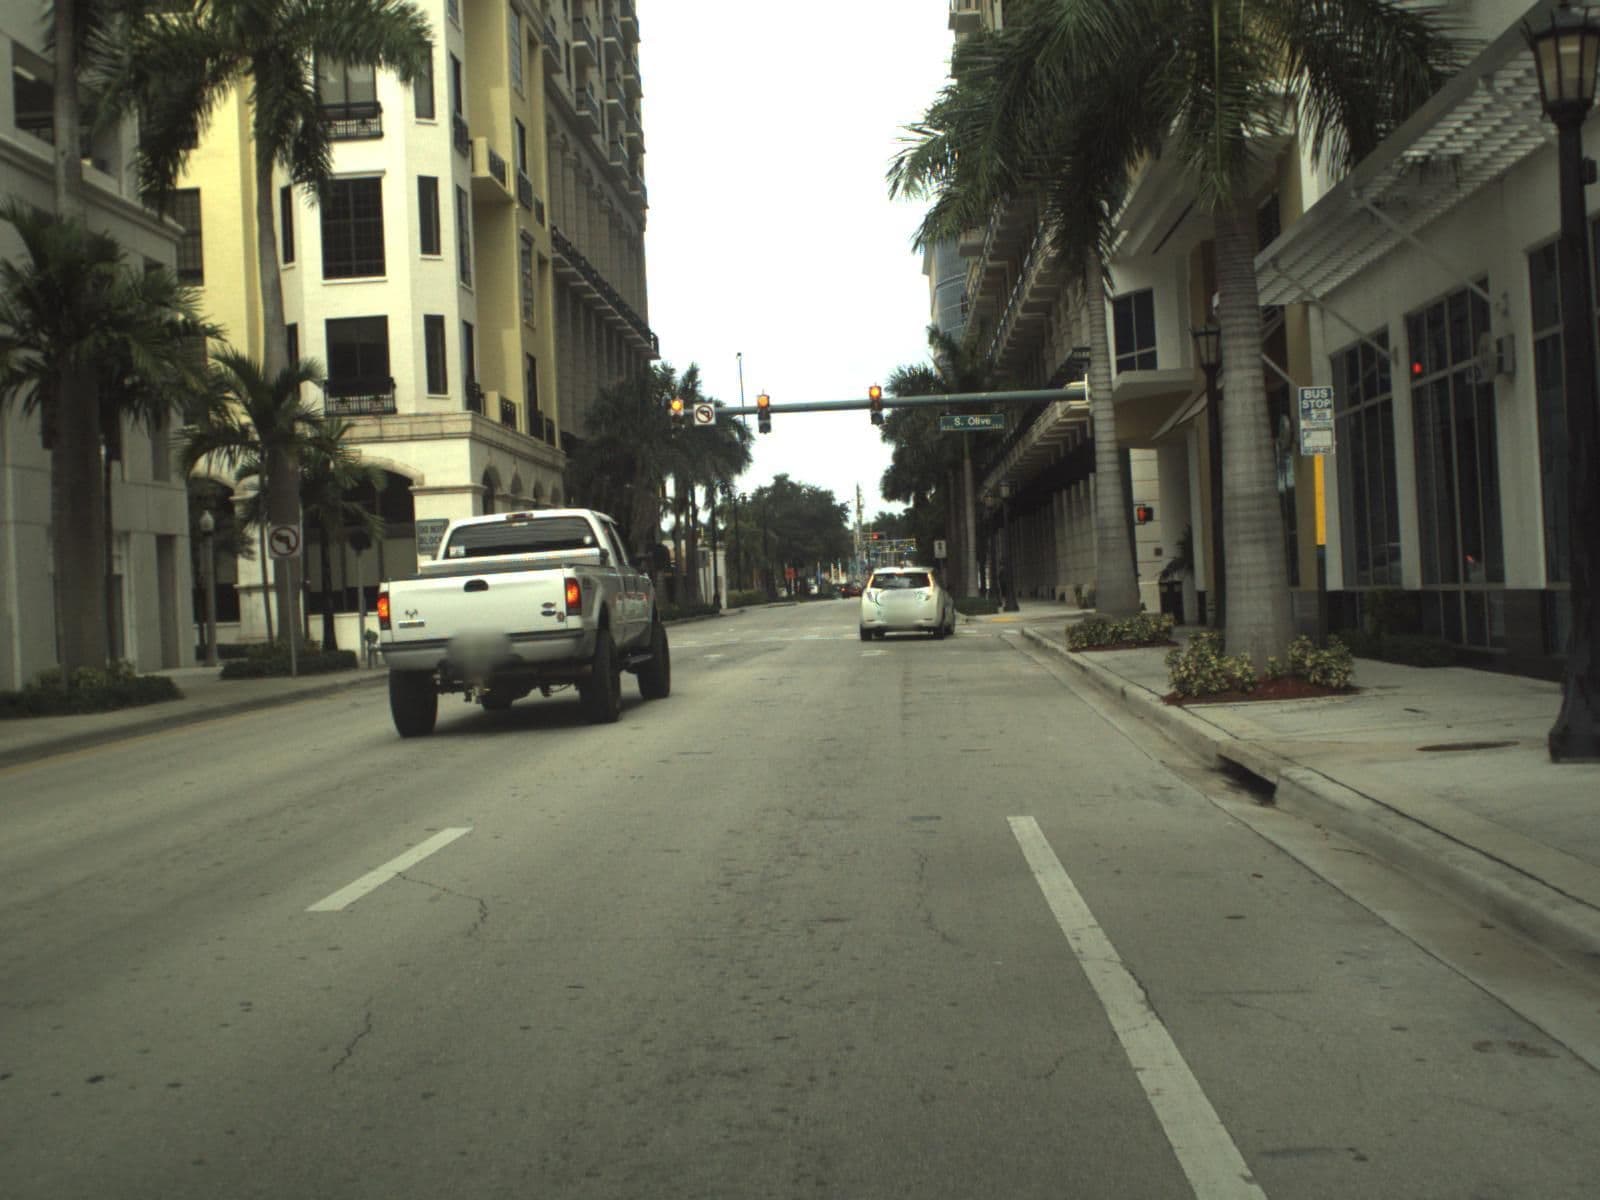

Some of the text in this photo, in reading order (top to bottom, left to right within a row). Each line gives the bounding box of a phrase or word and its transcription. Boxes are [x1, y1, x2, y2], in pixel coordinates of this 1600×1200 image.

[1303, 389, 1328, 399] BUS
[1302, 399, 1331, 409] STOP
[954, 416, 992, 426] S. Olive
